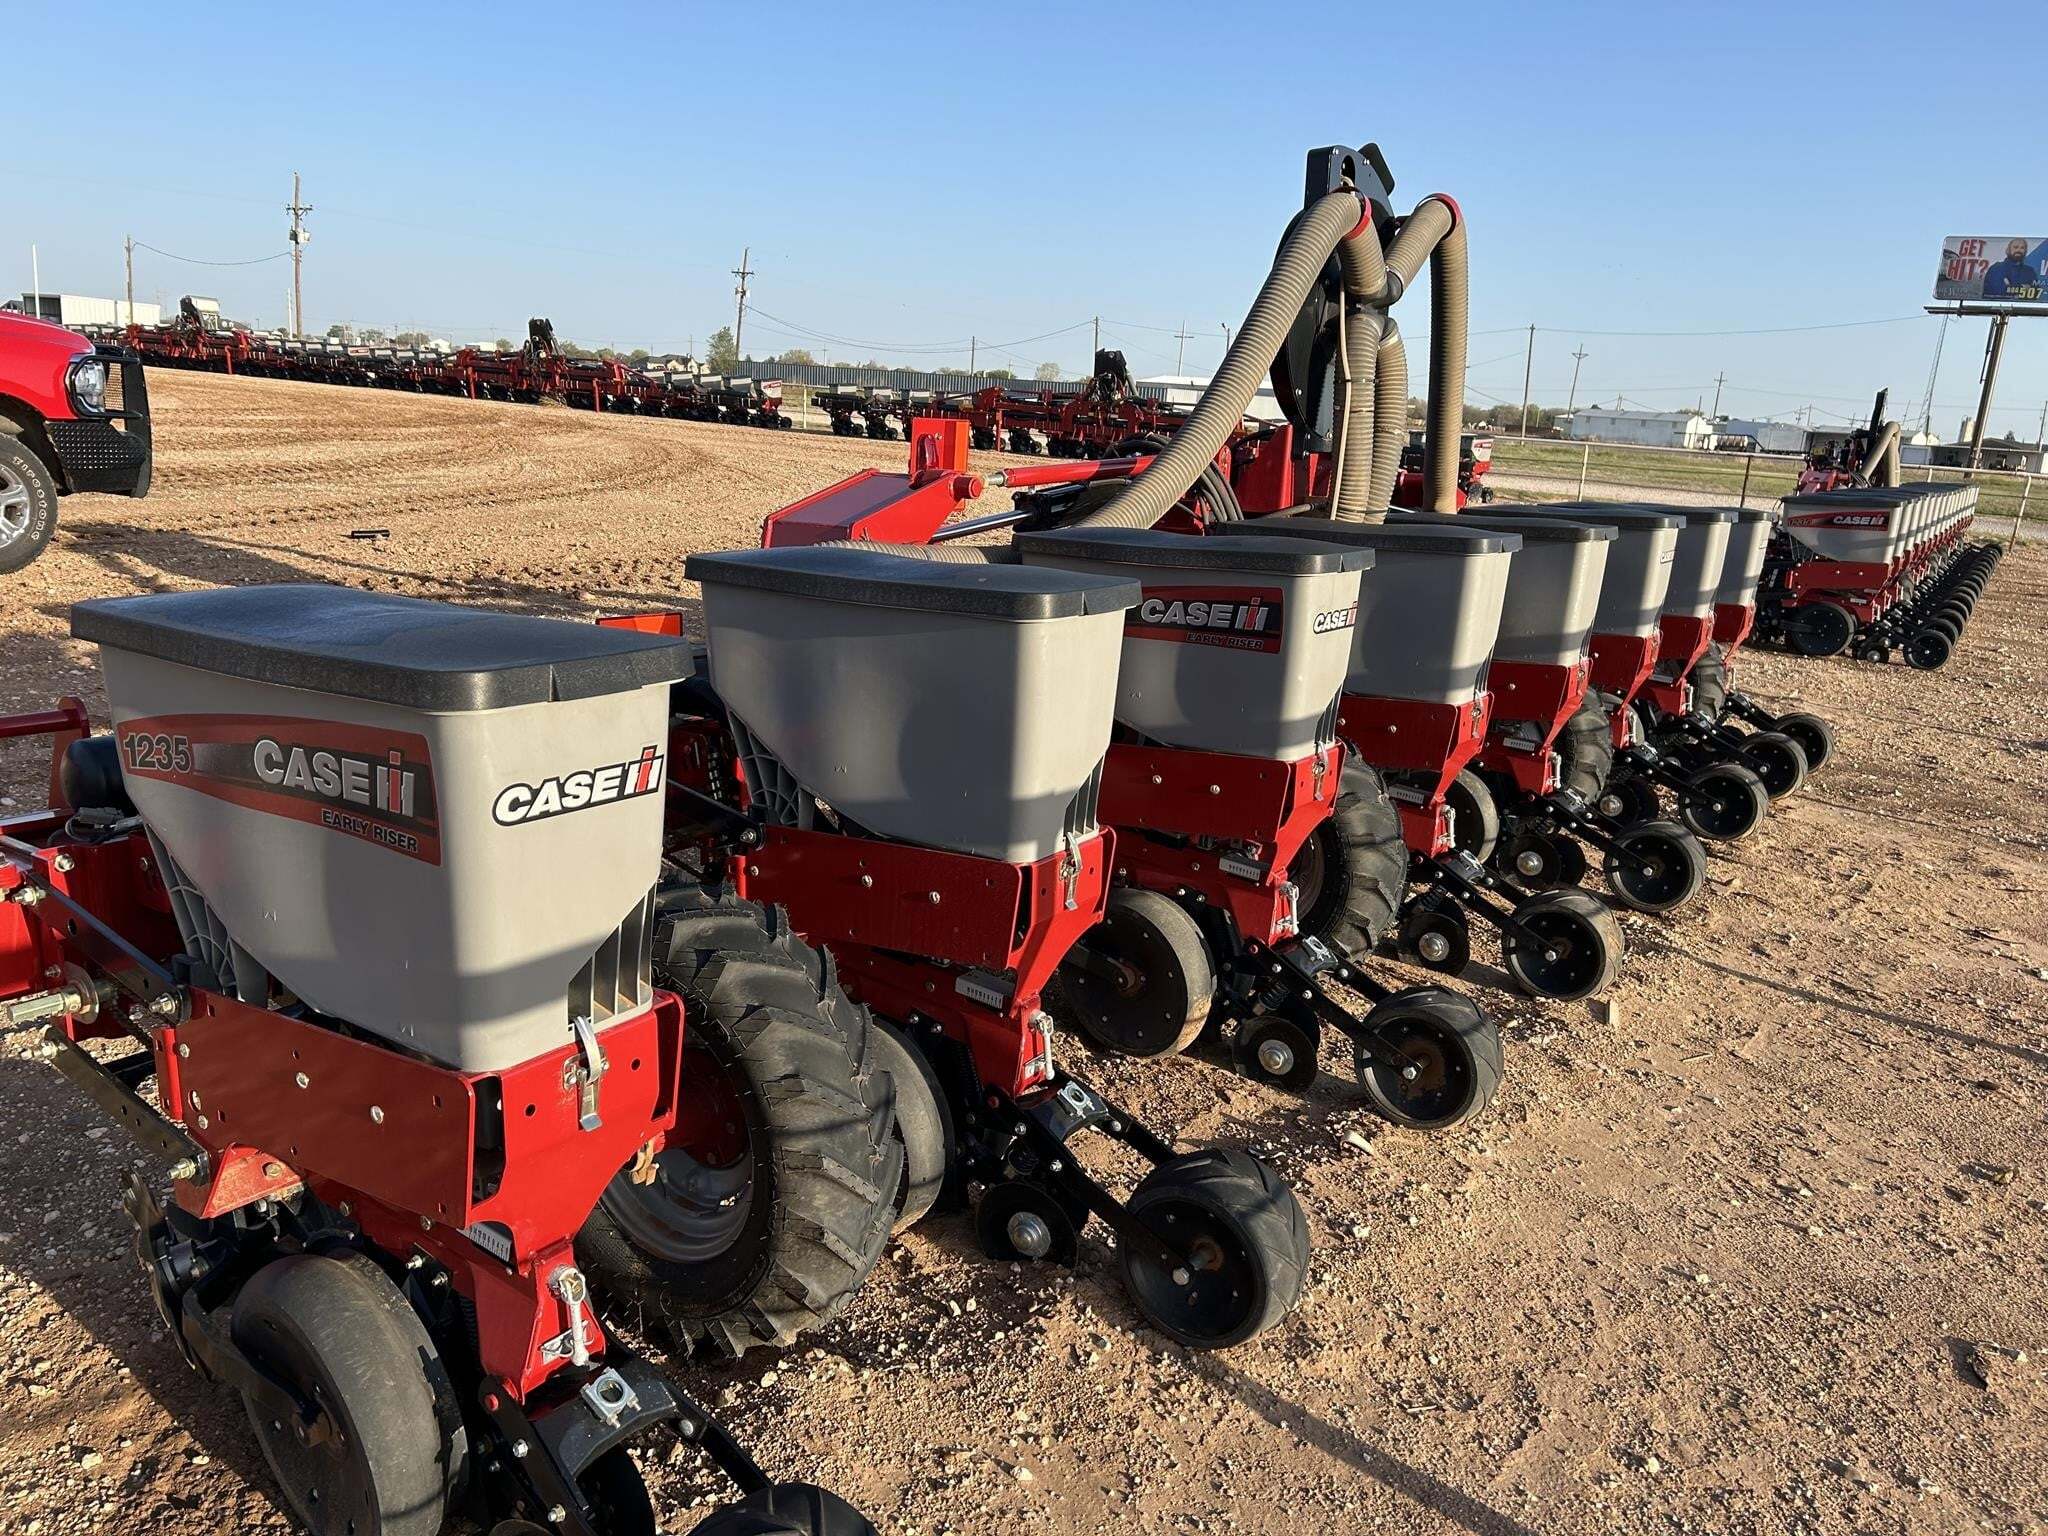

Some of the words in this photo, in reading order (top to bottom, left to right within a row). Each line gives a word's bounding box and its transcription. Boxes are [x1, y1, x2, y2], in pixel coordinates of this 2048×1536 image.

[1959, 239, 1987, 257] GET
[1946, 258, 1990, 281] HIT?
[1833, 515, 1870, 525] CASE
[1140, 599, 1233, 628] CASE
[1313, 608, 1349, 633] CASE
[1187, 632, 1226, 645] EARLY
[1227, 637, 1263, 650] RISER
[122, 731, 192, 772] 1235
[253, 738, 371, 802] CASE
[493, 766, 625, 825] CASE
[321, 809, 370, 838] EARLY
[372, 824, 419, 853] RISER
